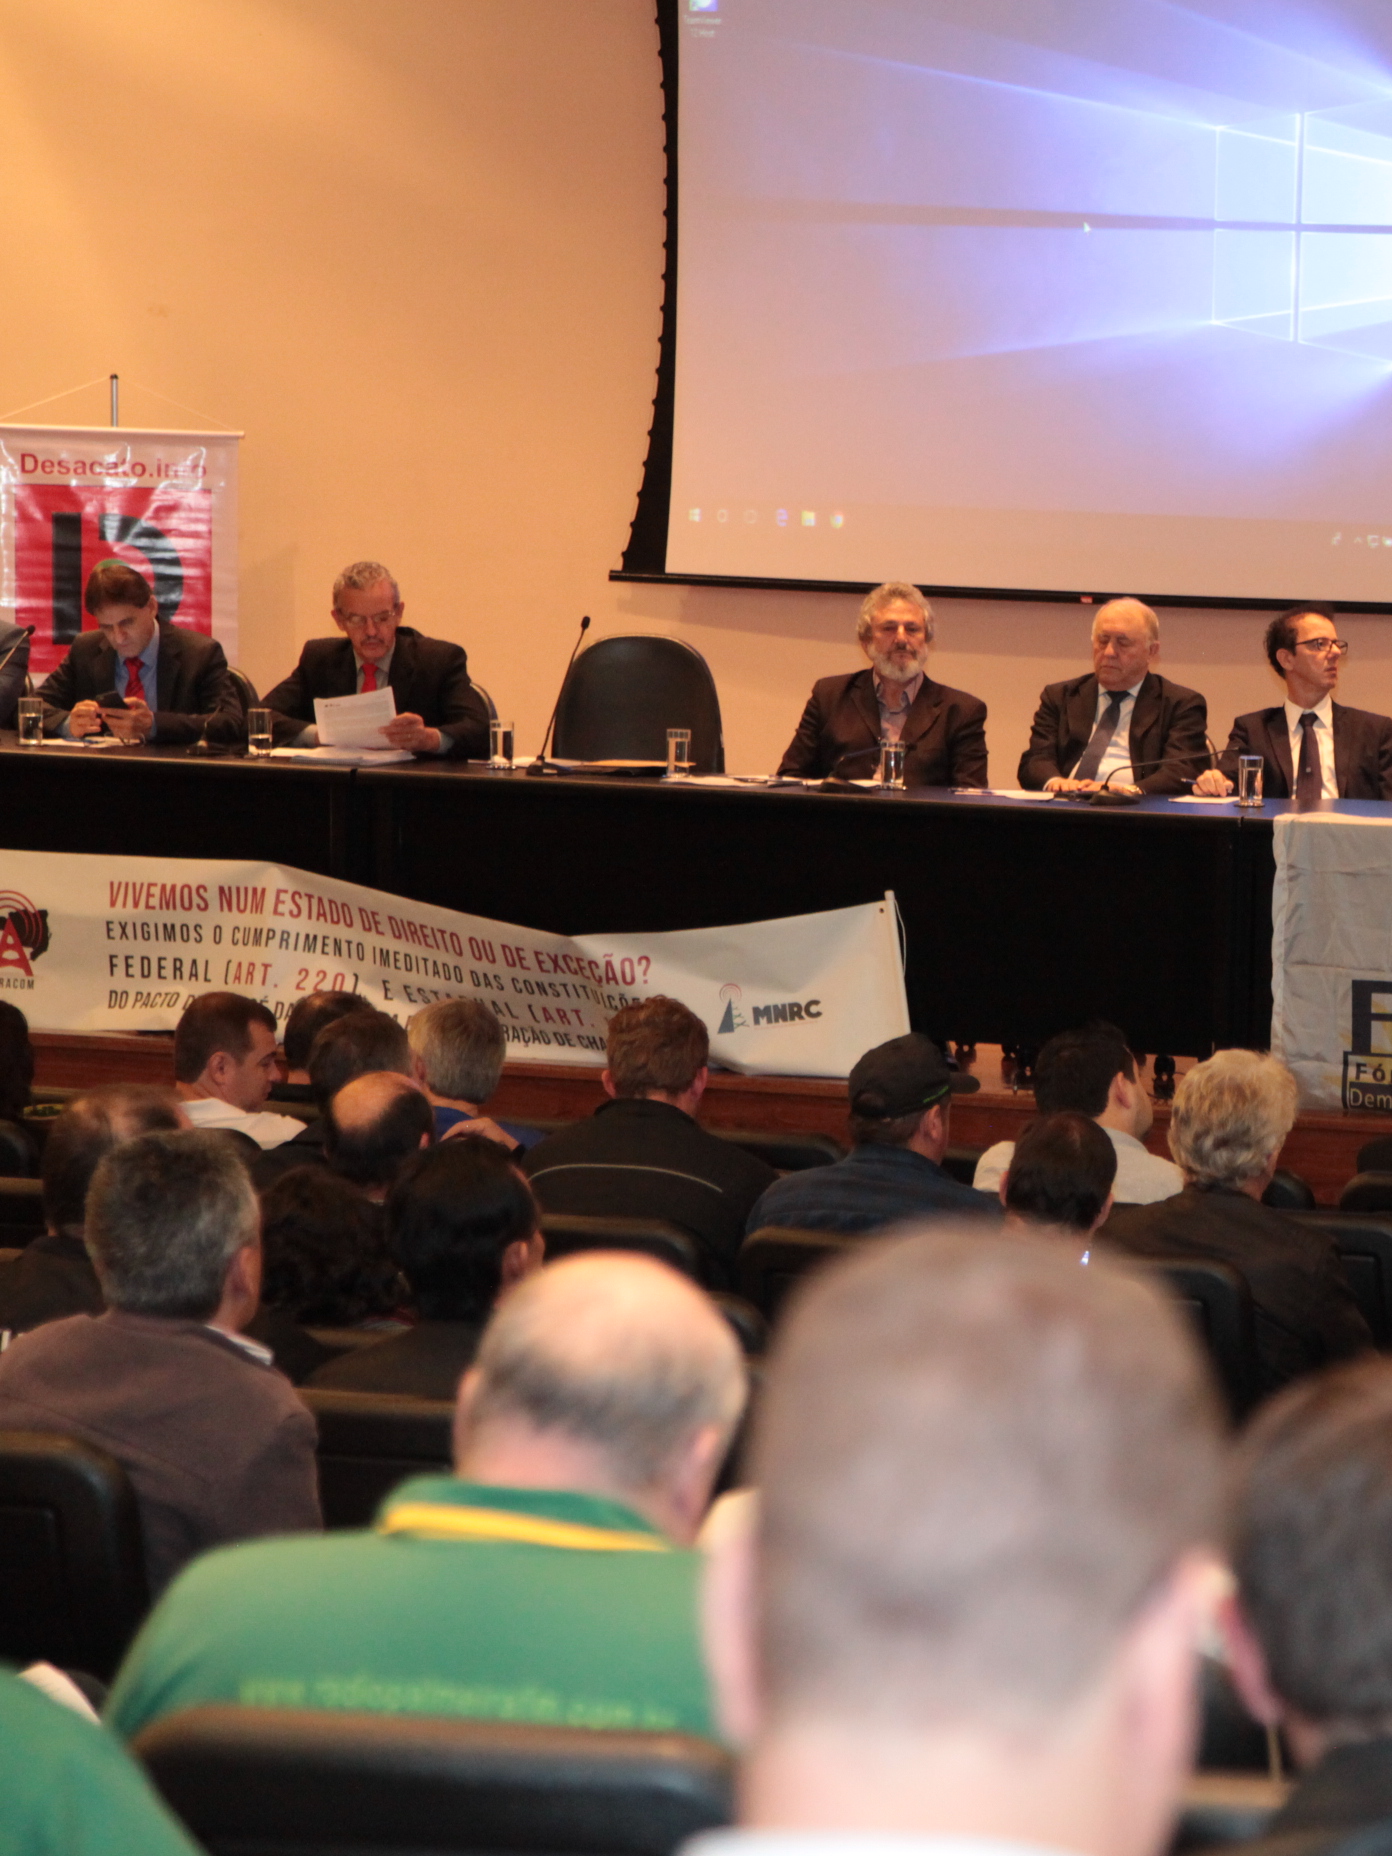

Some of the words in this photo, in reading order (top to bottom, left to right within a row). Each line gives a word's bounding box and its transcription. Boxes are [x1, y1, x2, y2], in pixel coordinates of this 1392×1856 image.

[106, 920, 203, 943] EXIGIMOS
[213, 925, 222, 945] O
[231, 926, 365, 961] CUMPRIMENTO
[373, 946, 464, 984] IMEDITADO
[470, 969, 505, 991] DAS
[108, 880, 209, 912] VIVEMOS
[218, 884, 267, 915] NUM
[272, 889, 354, 929] ESTADO
[358, 907, 385, 935] DE
[387, 915, 464, 957] DIREITO
[469, 936, 497, 964] OU
[501, 943, 531, 971] DE
[535, 950, 651, 987] EXCEÇÃO?
[108, 955, 212, 983] FEDERAL
[225, 959, 280, 988] (ART.
[382, 979, 394, 1001] E
[403, 985, 519, 1020] ESTAL
[108, 990, 128, 1010] DO
[132, 990, 178, 1010] PACTO
[502, 1024, 551, 1048] RAÇÃO
[553, 1031, 576, 1048] DE
[752, 1000, 823, 1025] MNRC
